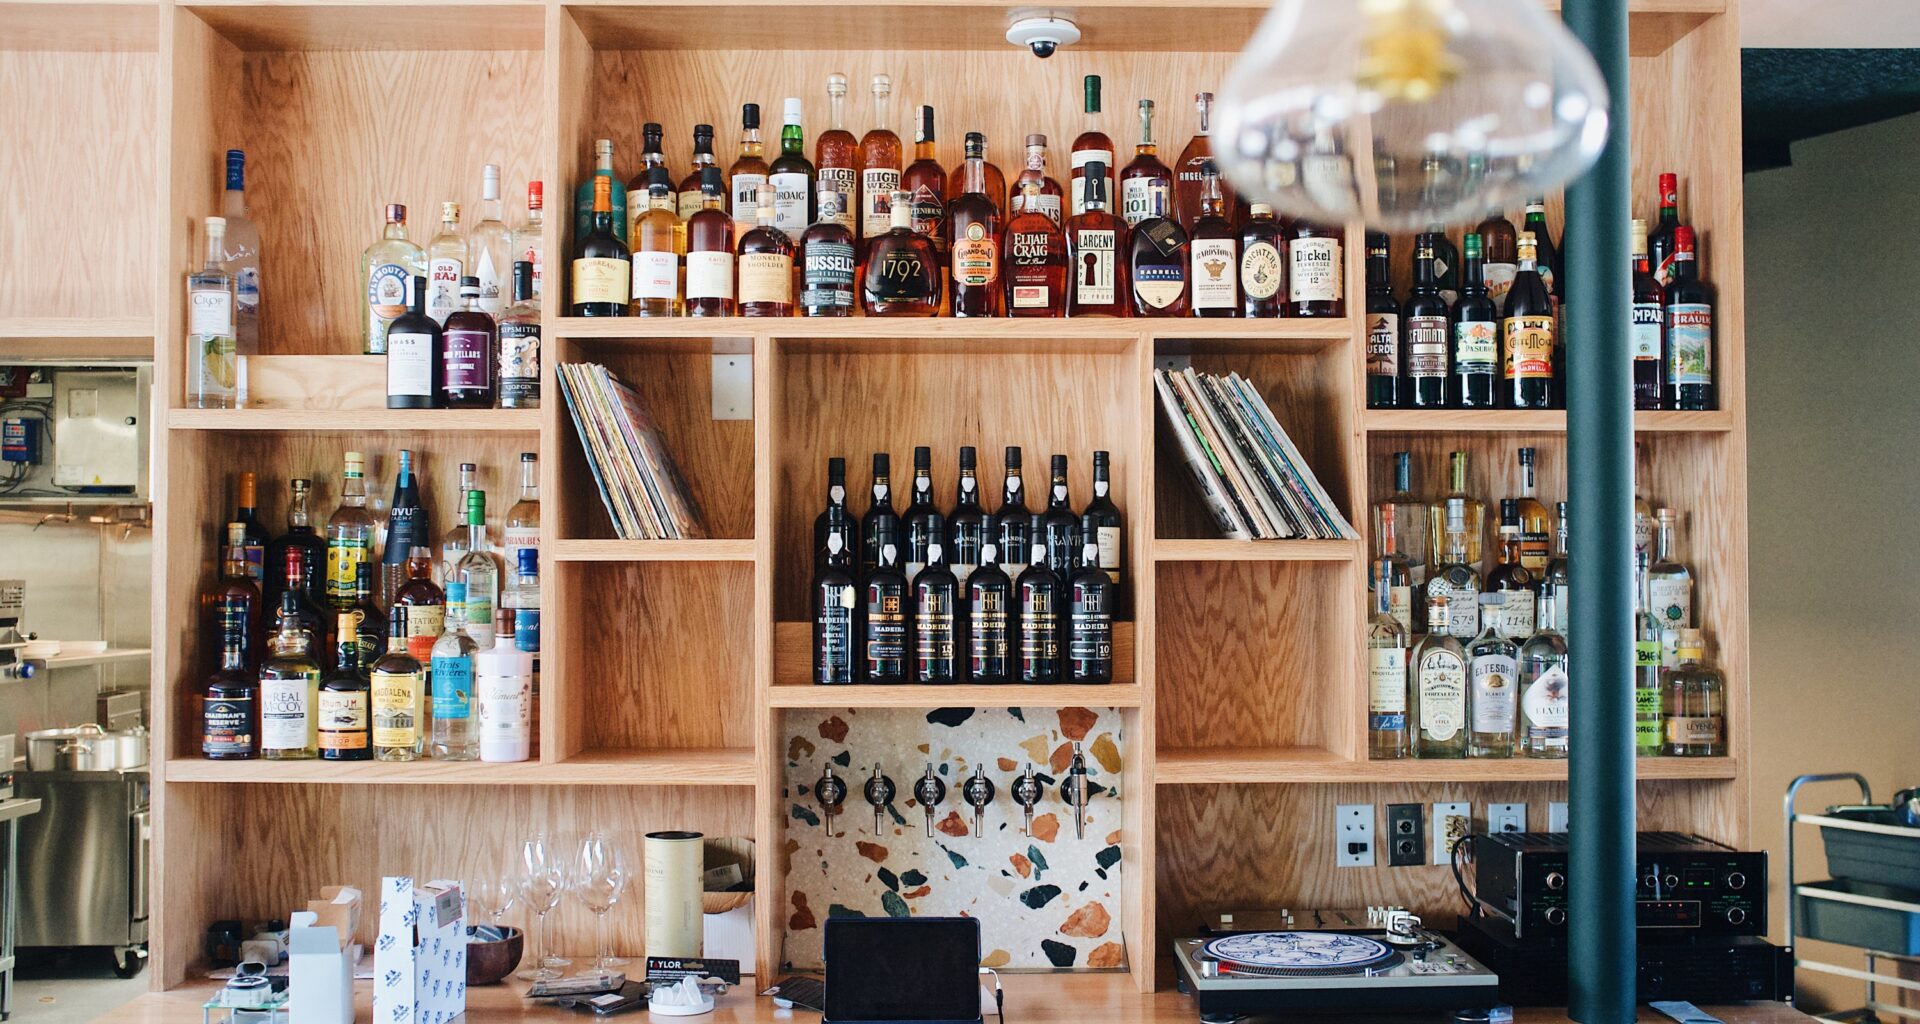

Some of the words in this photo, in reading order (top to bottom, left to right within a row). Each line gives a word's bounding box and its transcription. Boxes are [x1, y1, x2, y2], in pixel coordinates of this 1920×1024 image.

[821, 170, 855, 180] HIGH
[867, 172, 899, 182] HIGH
[1180, 172, 1203, 181] ANGEL
[777, 191, 805, 200] ROAIG
[1126, 200, 1147, 213] 101
[1014, 233, 1048, 246] ELIJAH
[1080, 234, 1114, 248] LARCENY
[1014, 244, 1048, 257] CRAIG
[1296, 250, 1330, 262] Dickel
[882, 260, 921, 282] 1792
[370, 266, 406, 294] PLYMOUTH
[434, 272, 457, 281] RAJ
[1634, 310, 1664, 322] MPARI
[1370, 334, 1392, 343] ALTA
[1367, 344, 1394, 354] VERDE
[408, 616, 438, 625] NTATION
[1506, 616, 1533, 626] 1146
[1100, 645, 1110, 654] 10
[274, 692, 302, 702] REAL
